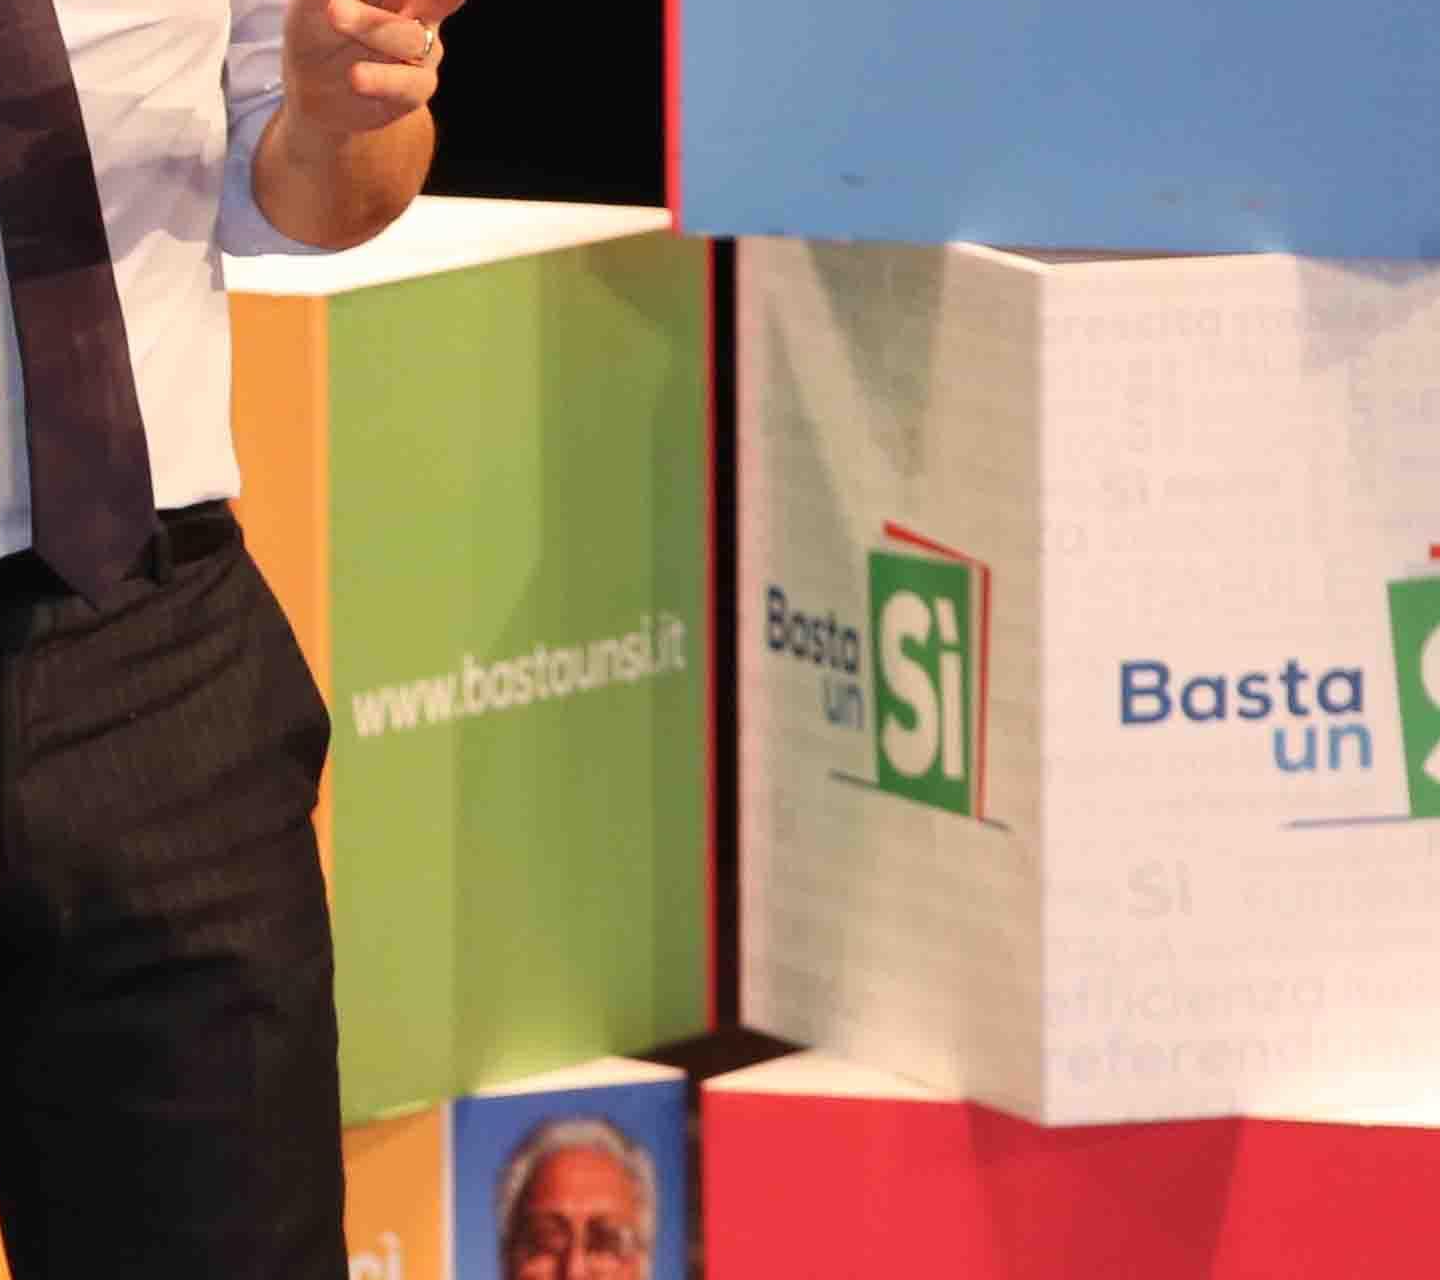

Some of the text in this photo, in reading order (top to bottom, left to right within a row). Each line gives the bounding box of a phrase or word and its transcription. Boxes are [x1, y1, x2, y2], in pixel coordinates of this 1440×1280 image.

[768, 587, 862, 677] Basta
[352, 611, 687, 738] www.bastaunsi.it
[822, 673, 864, 732] un
[881, 588, 964, 781] Sì
[1119, 657, 1368, 725] Basta
[1271, 722, 1373, 774] un
